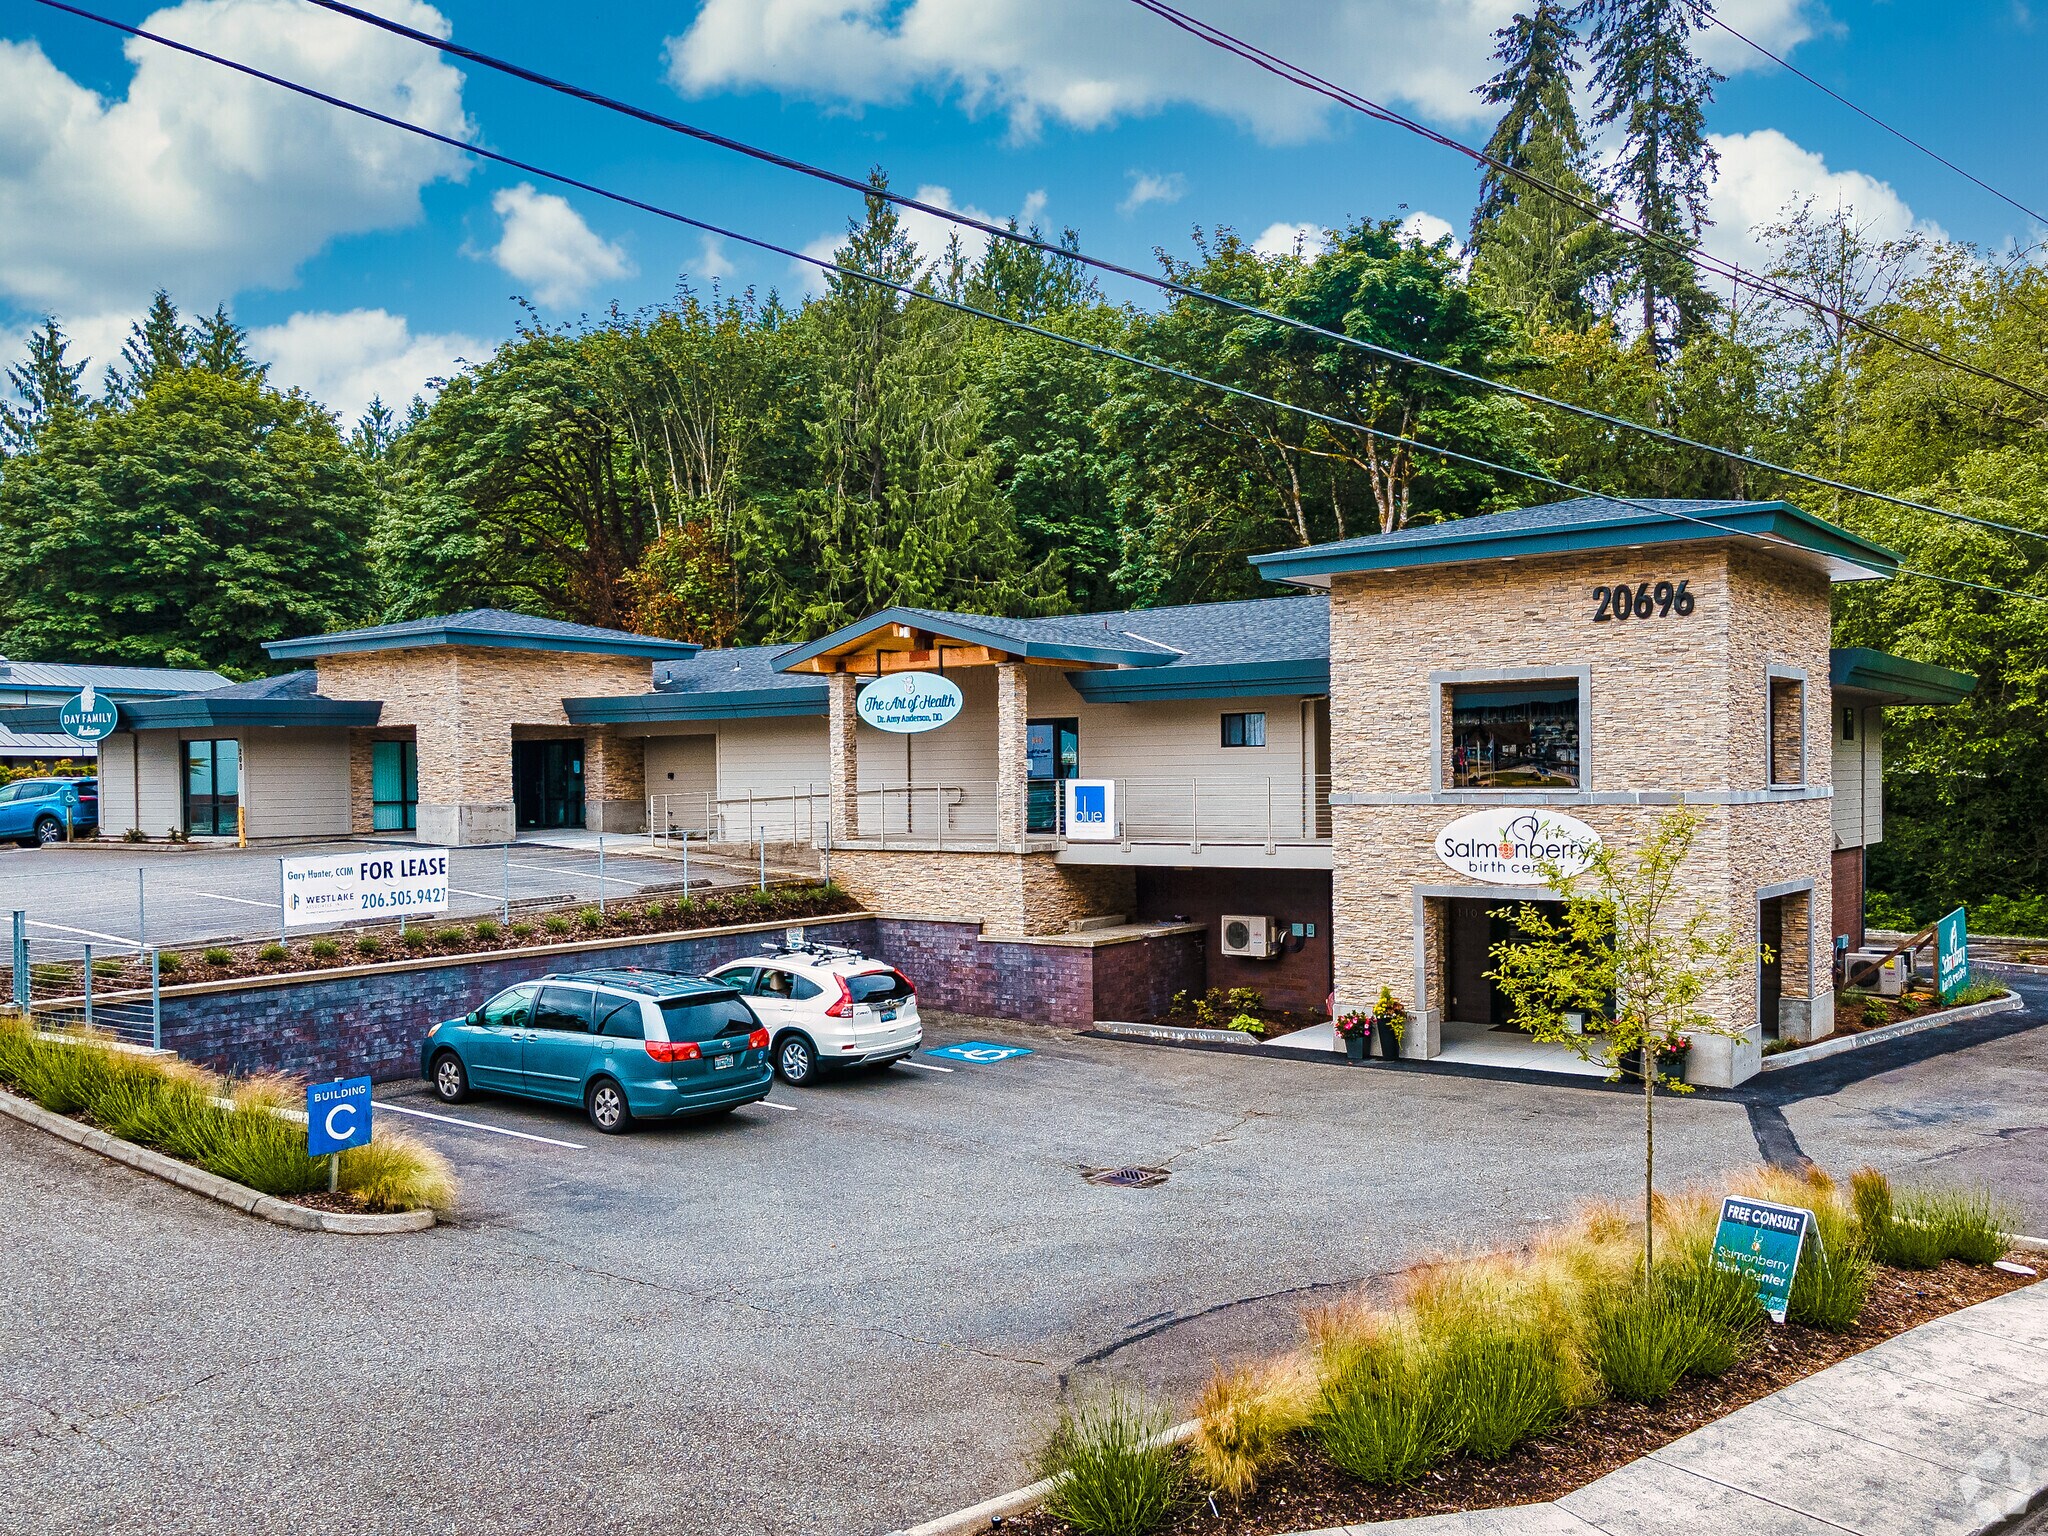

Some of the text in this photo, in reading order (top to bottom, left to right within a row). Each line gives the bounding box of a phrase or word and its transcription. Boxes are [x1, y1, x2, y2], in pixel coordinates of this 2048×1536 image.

[1593, 580, 1695, 622] 20696
[865, 694, 955, 712] The Art of Health
[64, 713, 112, 724] DAY FAMILY
[877, 715, 885, 723] Dr.
[887, 715, 900, 724] Amy
[1075, 796, 1103, 823] blue
[288, 867, 354, 882] Gary Hunter, CCIM
[361, 857, 446, 880] FOR LEASE
[1469, 861, 1506, 873] birth
[306, 892, 354, 904] WESTLAKE
[361, 888, 446, 909] 206.505.9427
[314, 1085, 366, 1102] BUILDING
[325, 1103, 357, 1140] C
[1727, 1204, 1800, 1231] FREE CONSULT
[1717, 1246, 1790, 1273] Salmonberry
